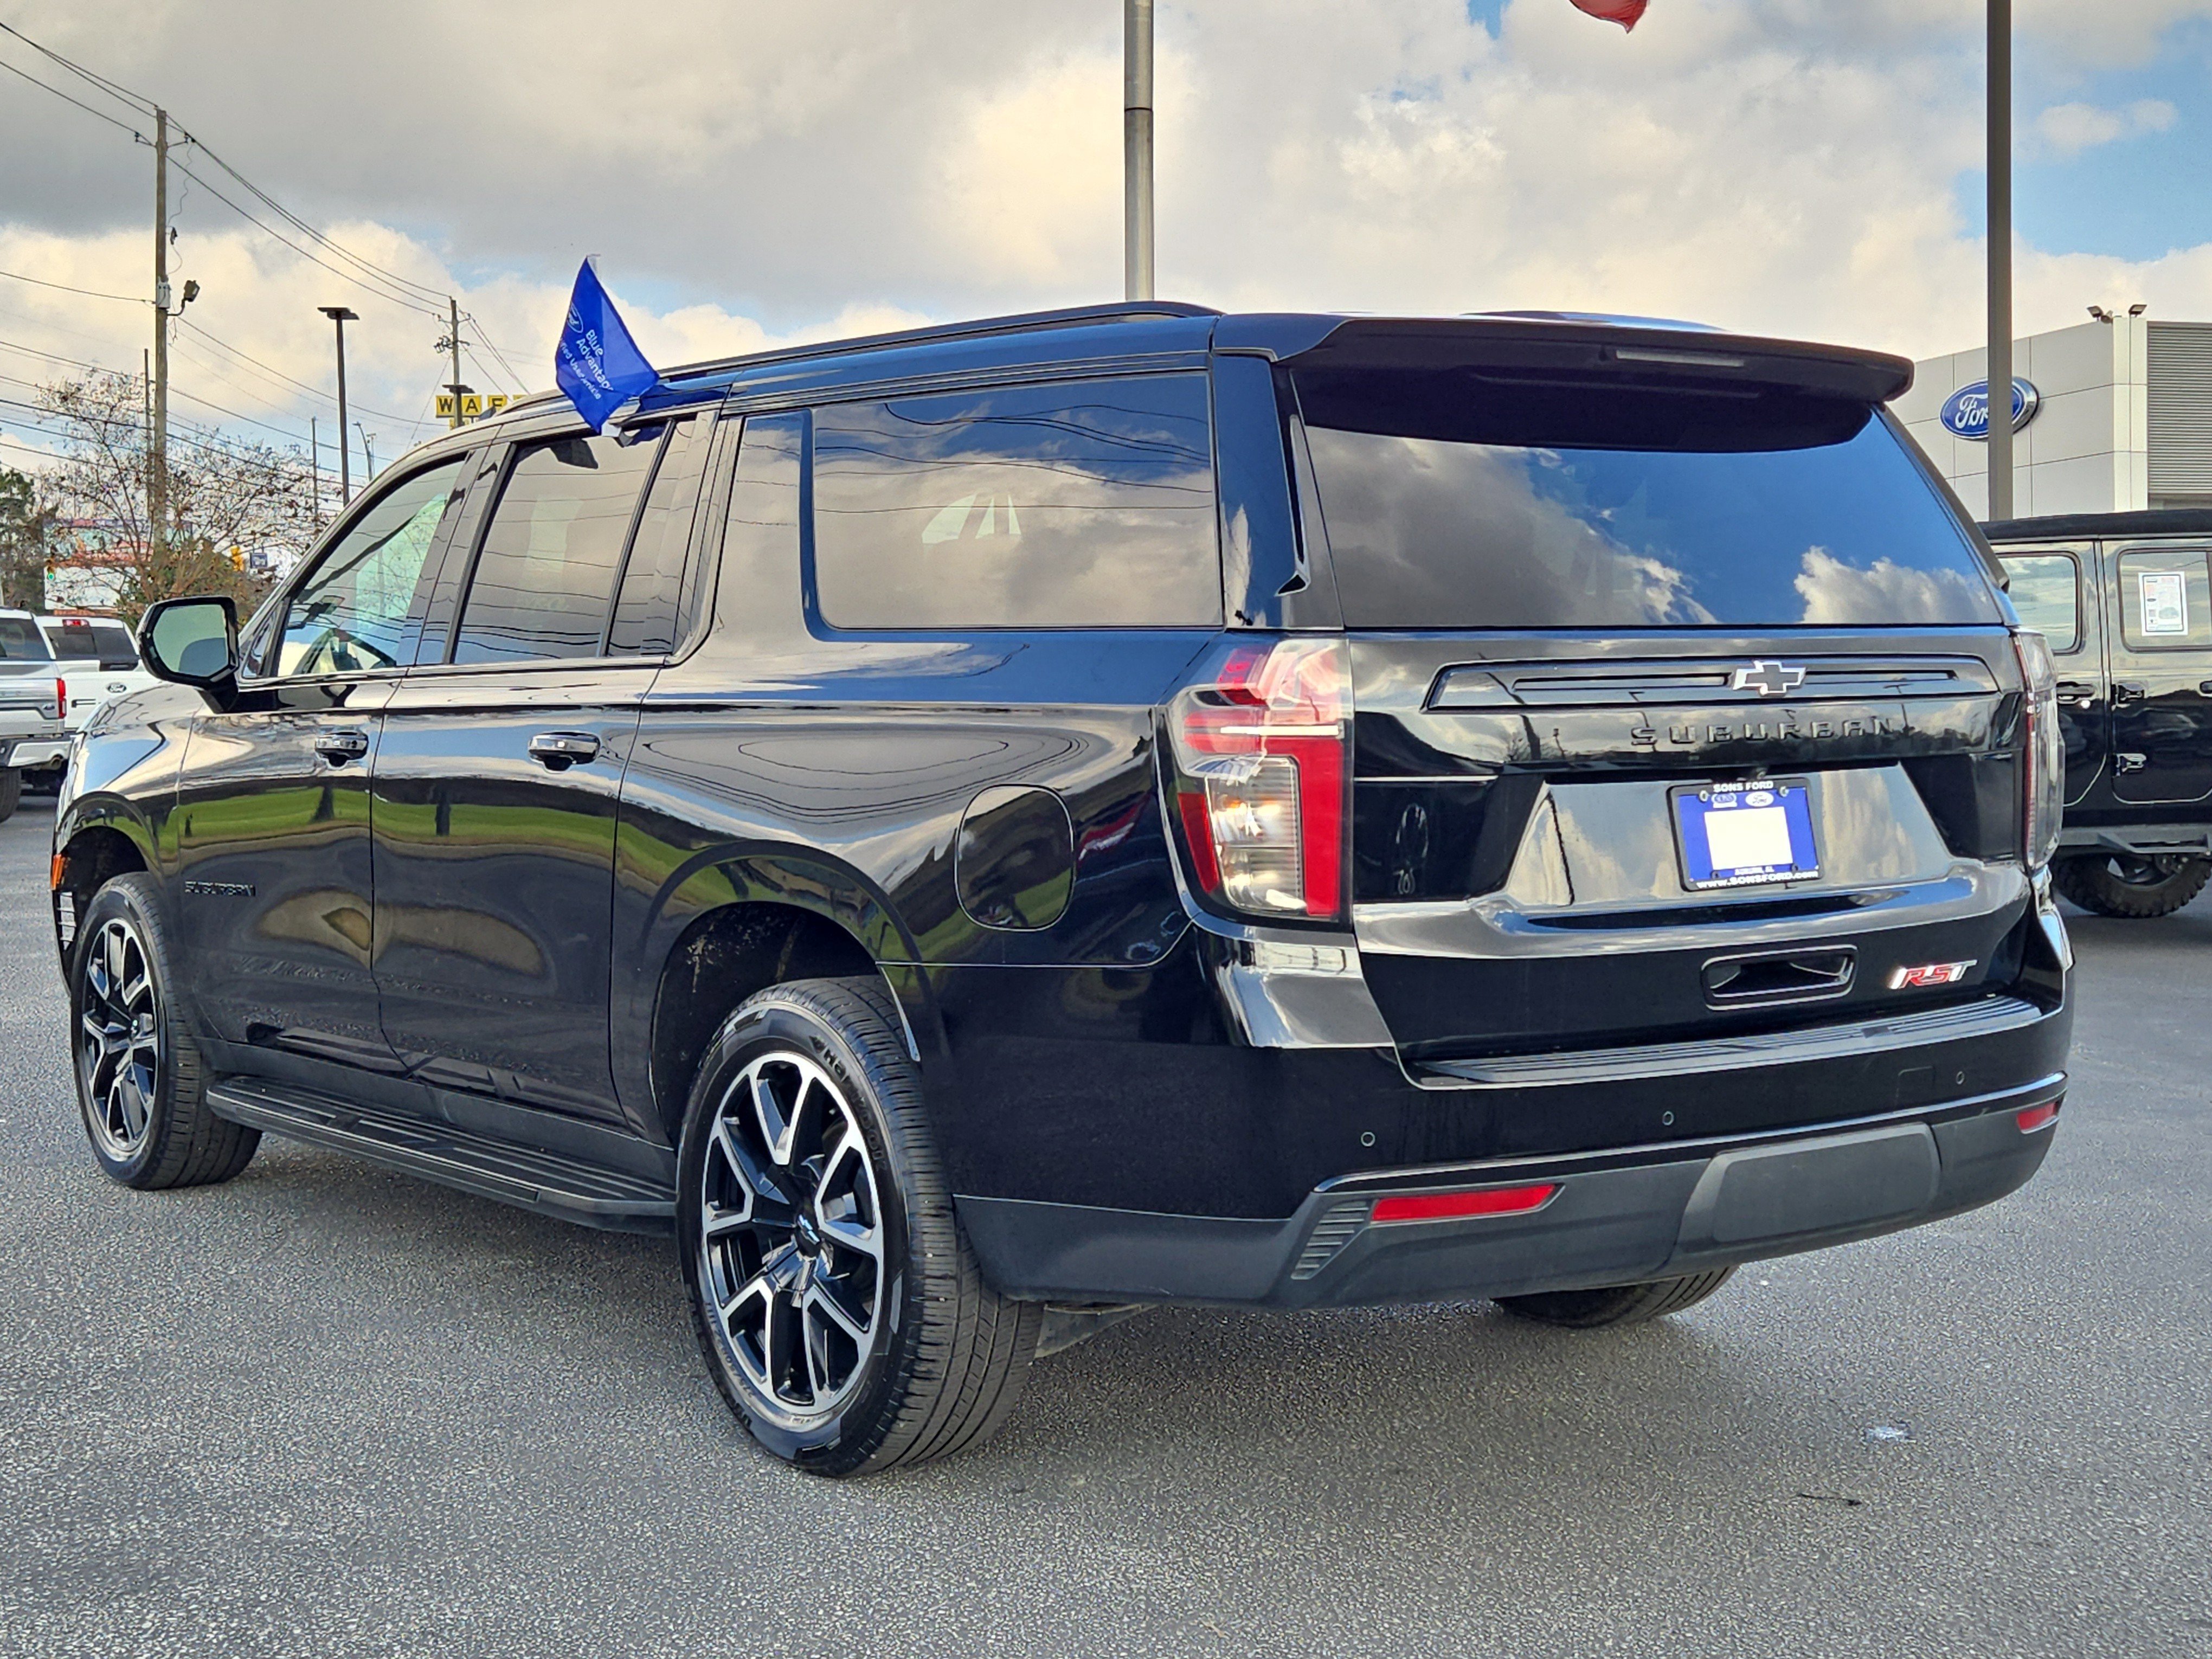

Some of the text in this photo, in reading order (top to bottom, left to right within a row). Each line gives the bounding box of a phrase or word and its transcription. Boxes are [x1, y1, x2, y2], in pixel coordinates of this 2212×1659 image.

[586, 329, 603, 357] Blue
[438, 397, 504, 413] WAF
[1631, 716, 1893, 746] SUBURBAN
[1713, 780, 1774, 793] SONS FORD
[1887, 959, 1982, 989] RST
